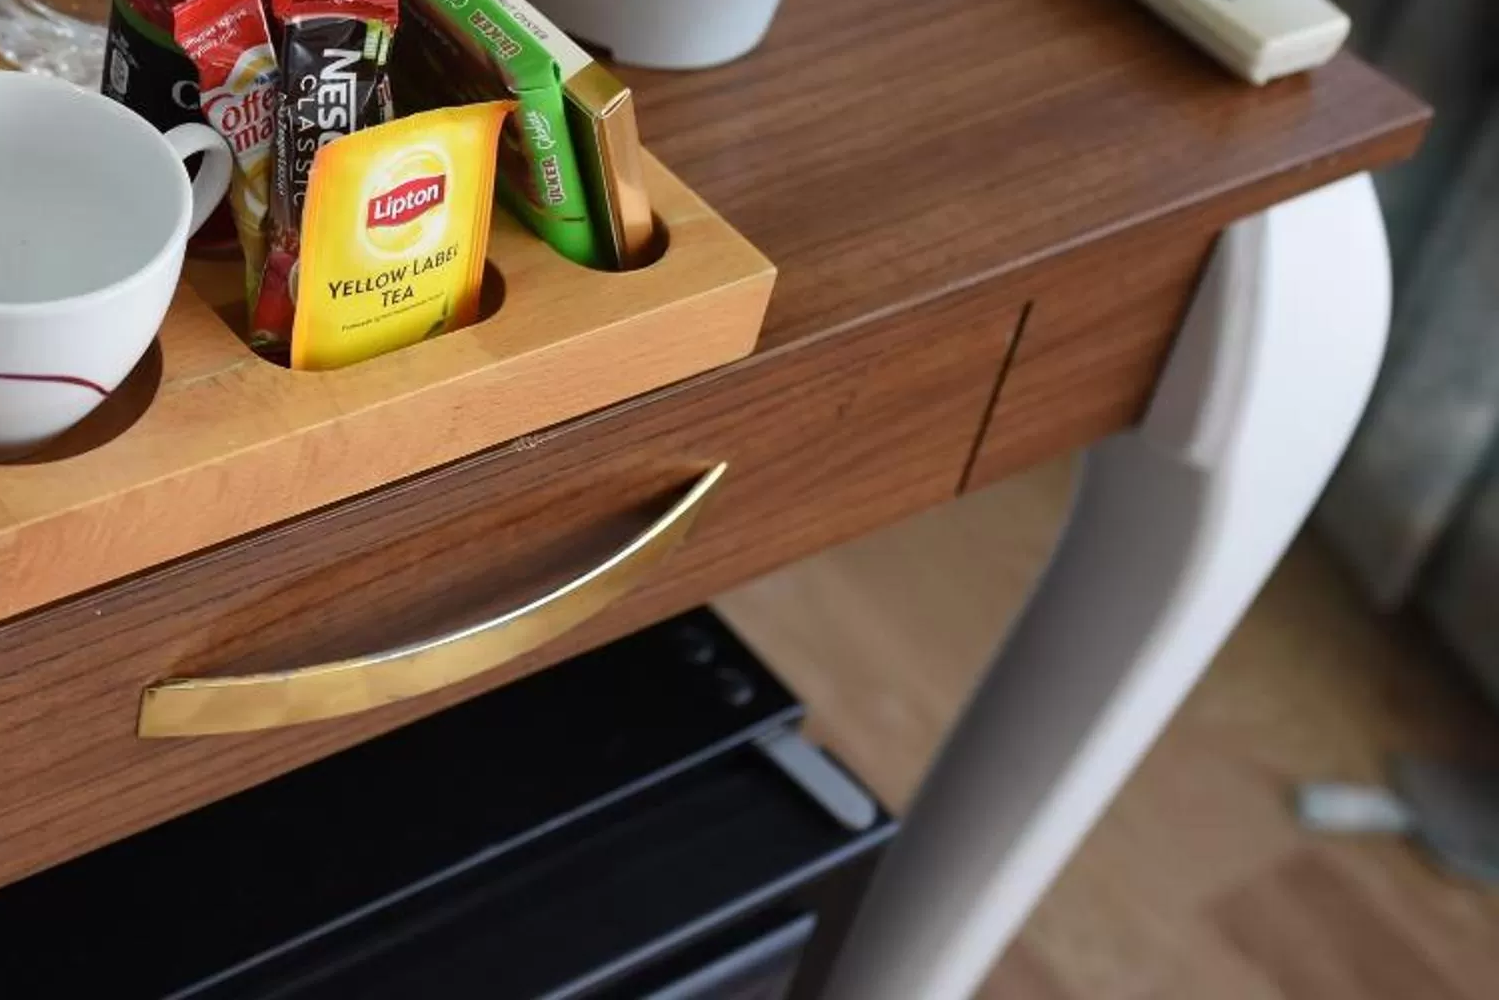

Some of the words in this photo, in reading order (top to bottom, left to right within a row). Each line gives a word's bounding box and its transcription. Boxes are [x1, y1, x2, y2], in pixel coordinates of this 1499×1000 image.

[201, 83, 278, 133] Coffe
[316, 49, 362, 146] NESC
[233, 111, 277, 152] ma
[293, 74, 318, 205] CLASSIC
[373, 183, 440, 220] Lipton
[328, 265, 408, 300] YELLOW
[381, 285, 415, 308] TEA
